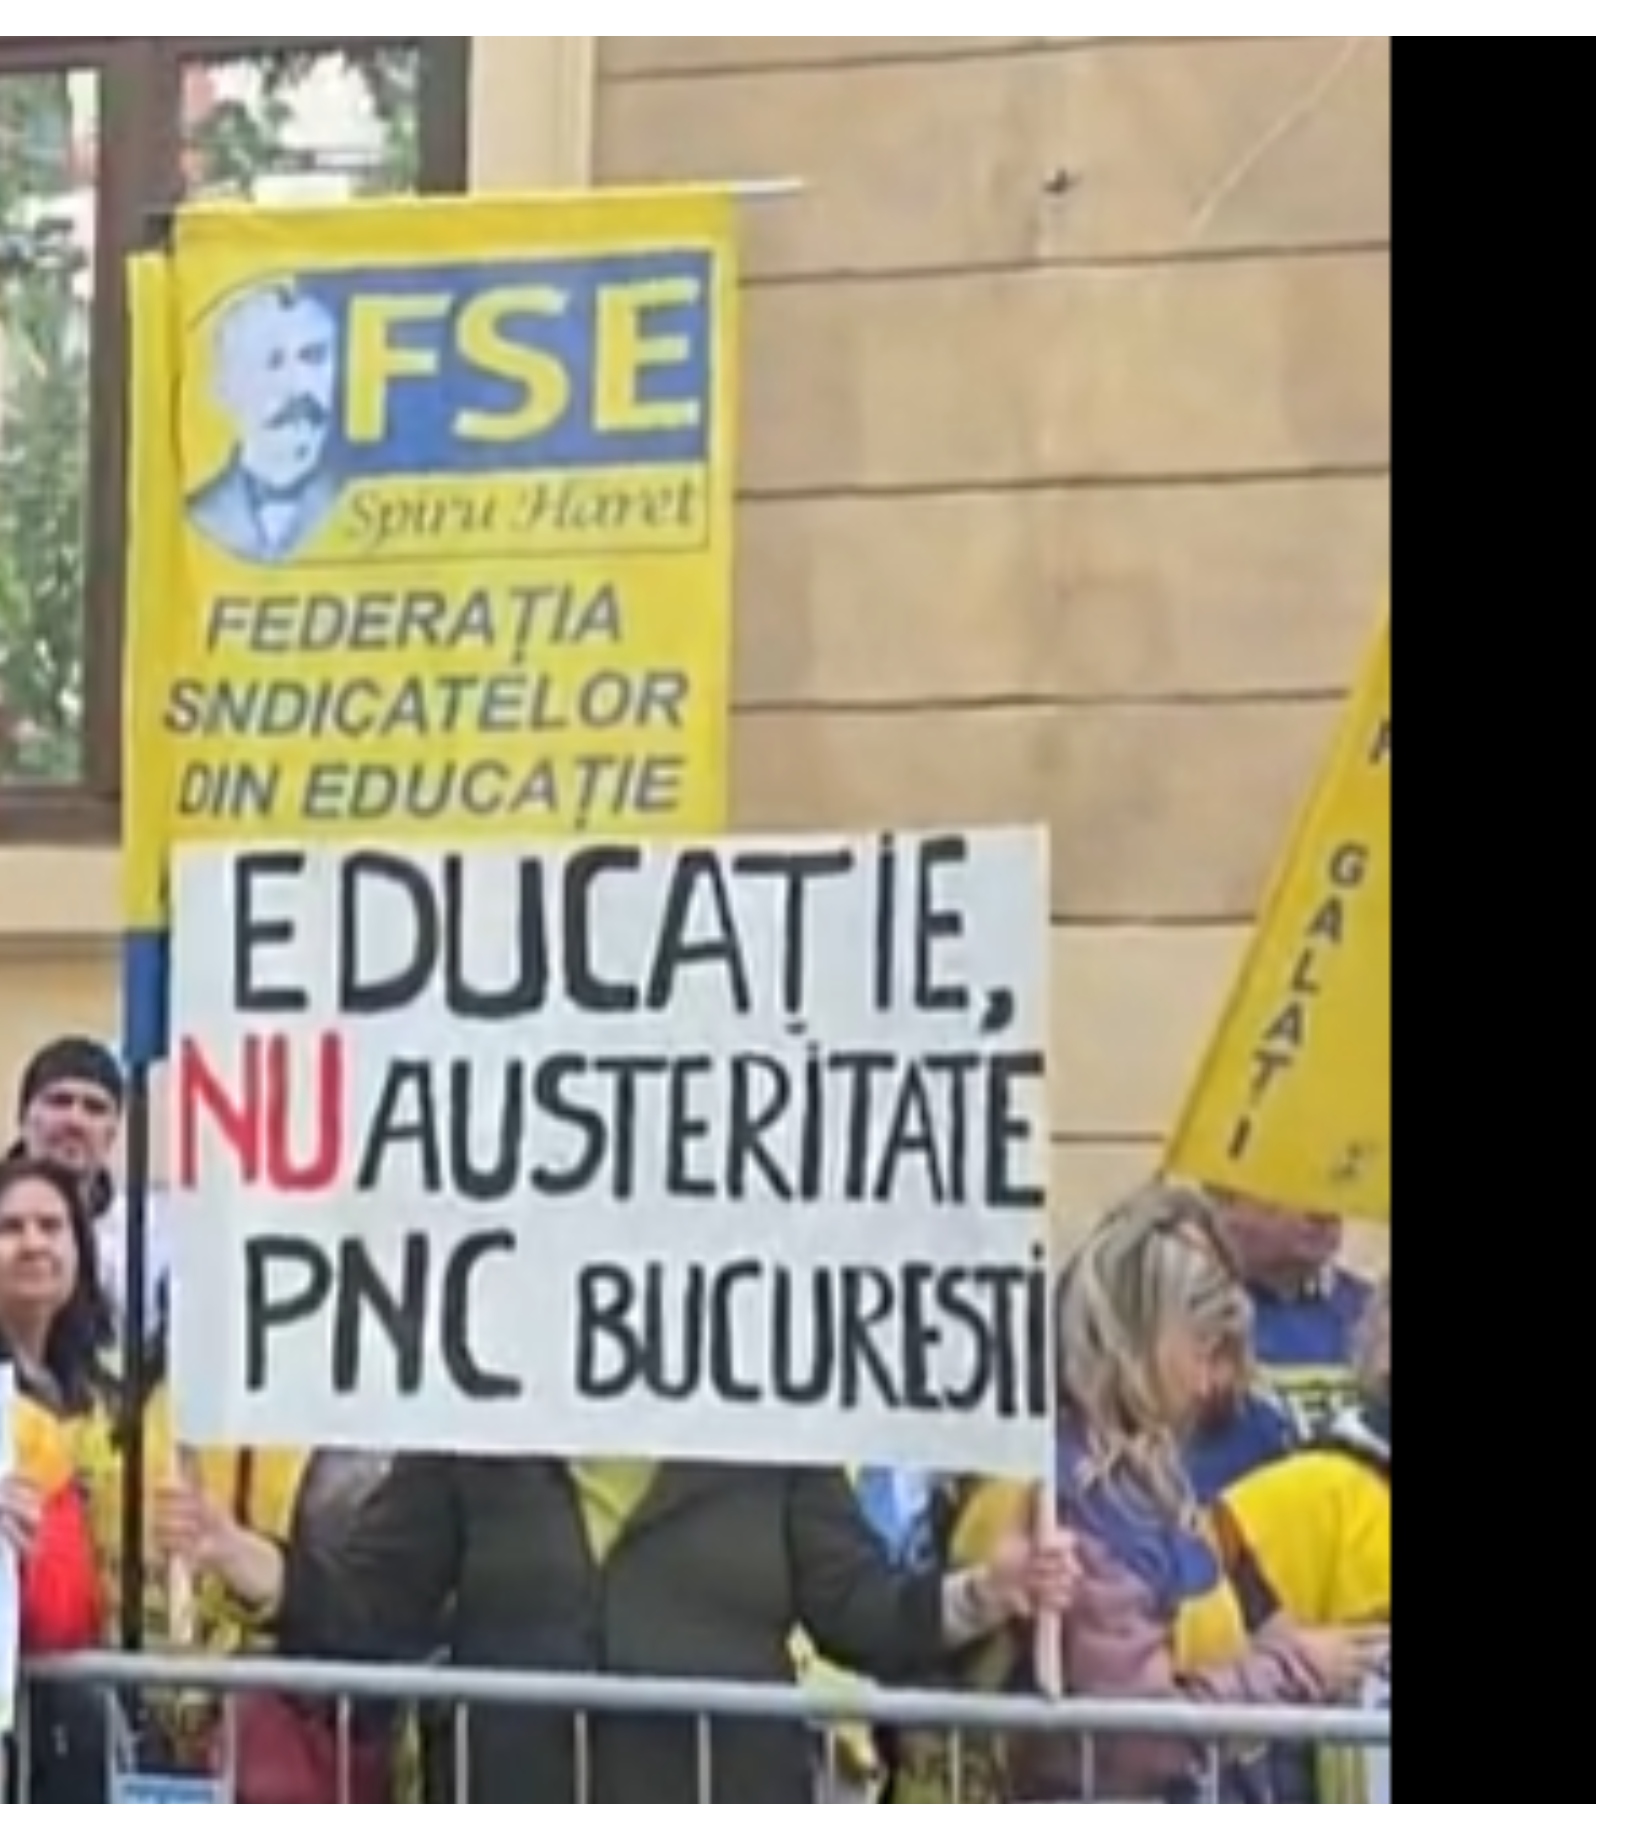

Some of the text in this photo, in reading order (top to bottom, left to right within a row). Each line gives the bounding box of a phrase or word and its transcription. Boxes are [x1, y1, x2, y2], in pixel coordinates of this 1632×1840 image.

[344, 275, 701, 444] FSE
[343, 486, 498, 546] Spiru
[206, 582, 624, 664] FEDERAȚIA
[178, 755, 686, 830] DIN EDUCAȚIE
[176, 1028, 1048, 1208] NU AUSTERITATE
[242, 1228, 524, 1400] PNC
